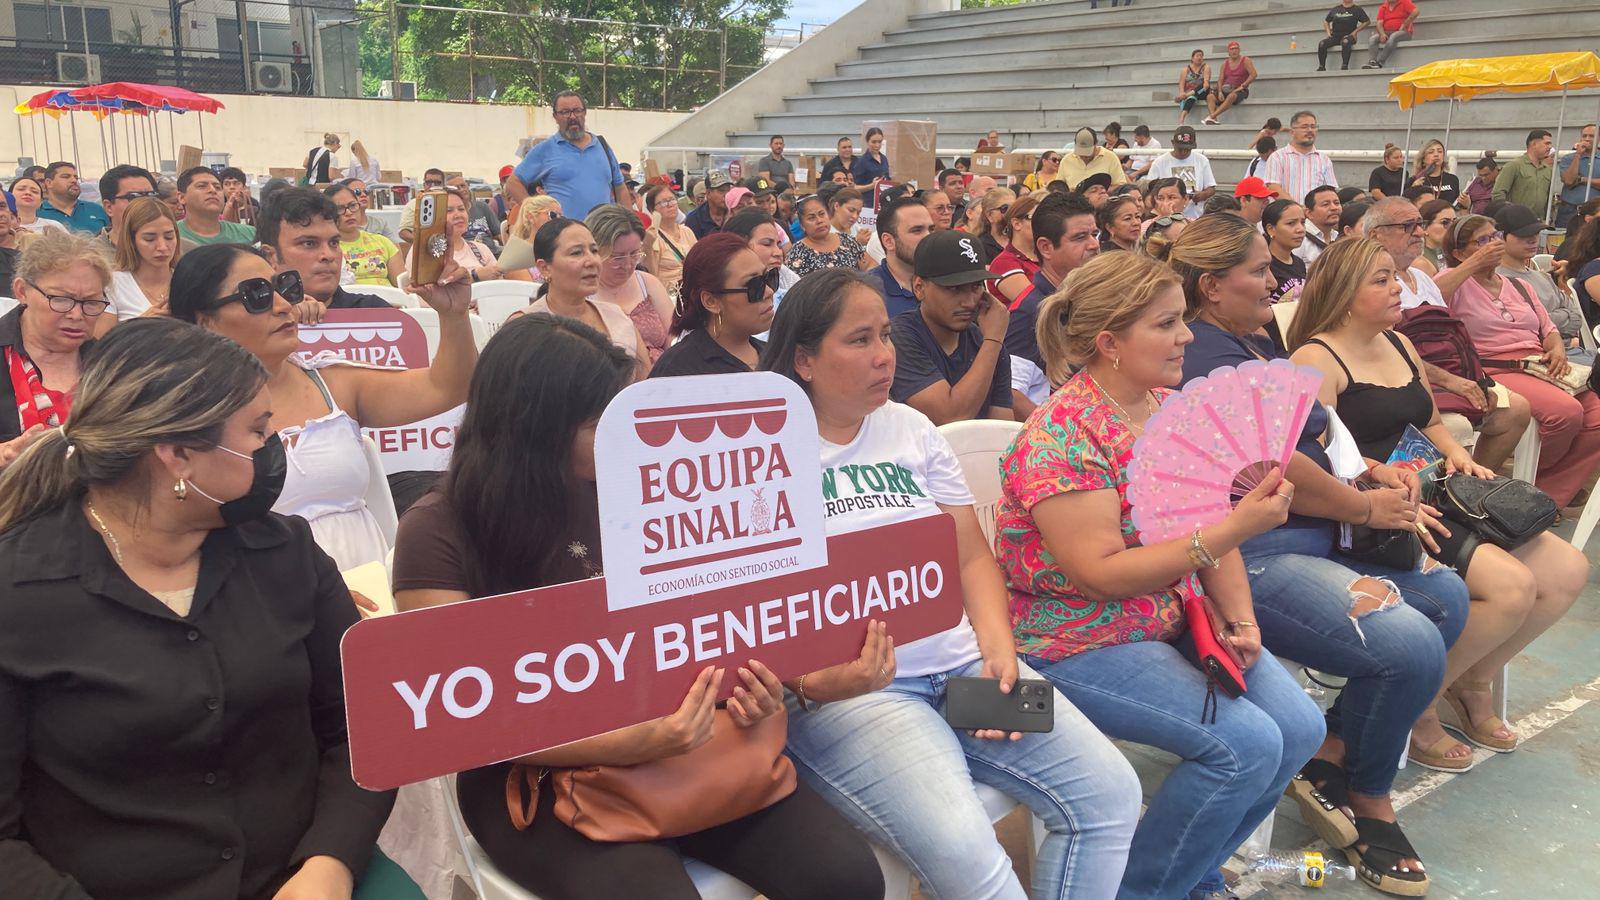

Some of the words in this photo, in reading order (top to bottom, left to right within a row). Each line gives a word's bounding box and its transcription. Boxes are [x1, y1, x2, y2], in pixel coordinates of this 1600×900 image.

[298, 345, 406, 366] EUIPA
[639, 443, 792, 505] EQUIPA
[839, 462, 926, 497] YORK
[823, 495, 915, 518] ROPOSTALE
[648, 575, 705, 596] ECONOMÍA
[706, 570, 727, 584] CON
[728, 562, 768, 579] SENTIDO
[769, 556, 799, 571] SOCIAL
[392, 666, 493, 730] YO
[514, 631, 636, 703] SOY
[653, 560, 944, 672] BENEFICIARIO
